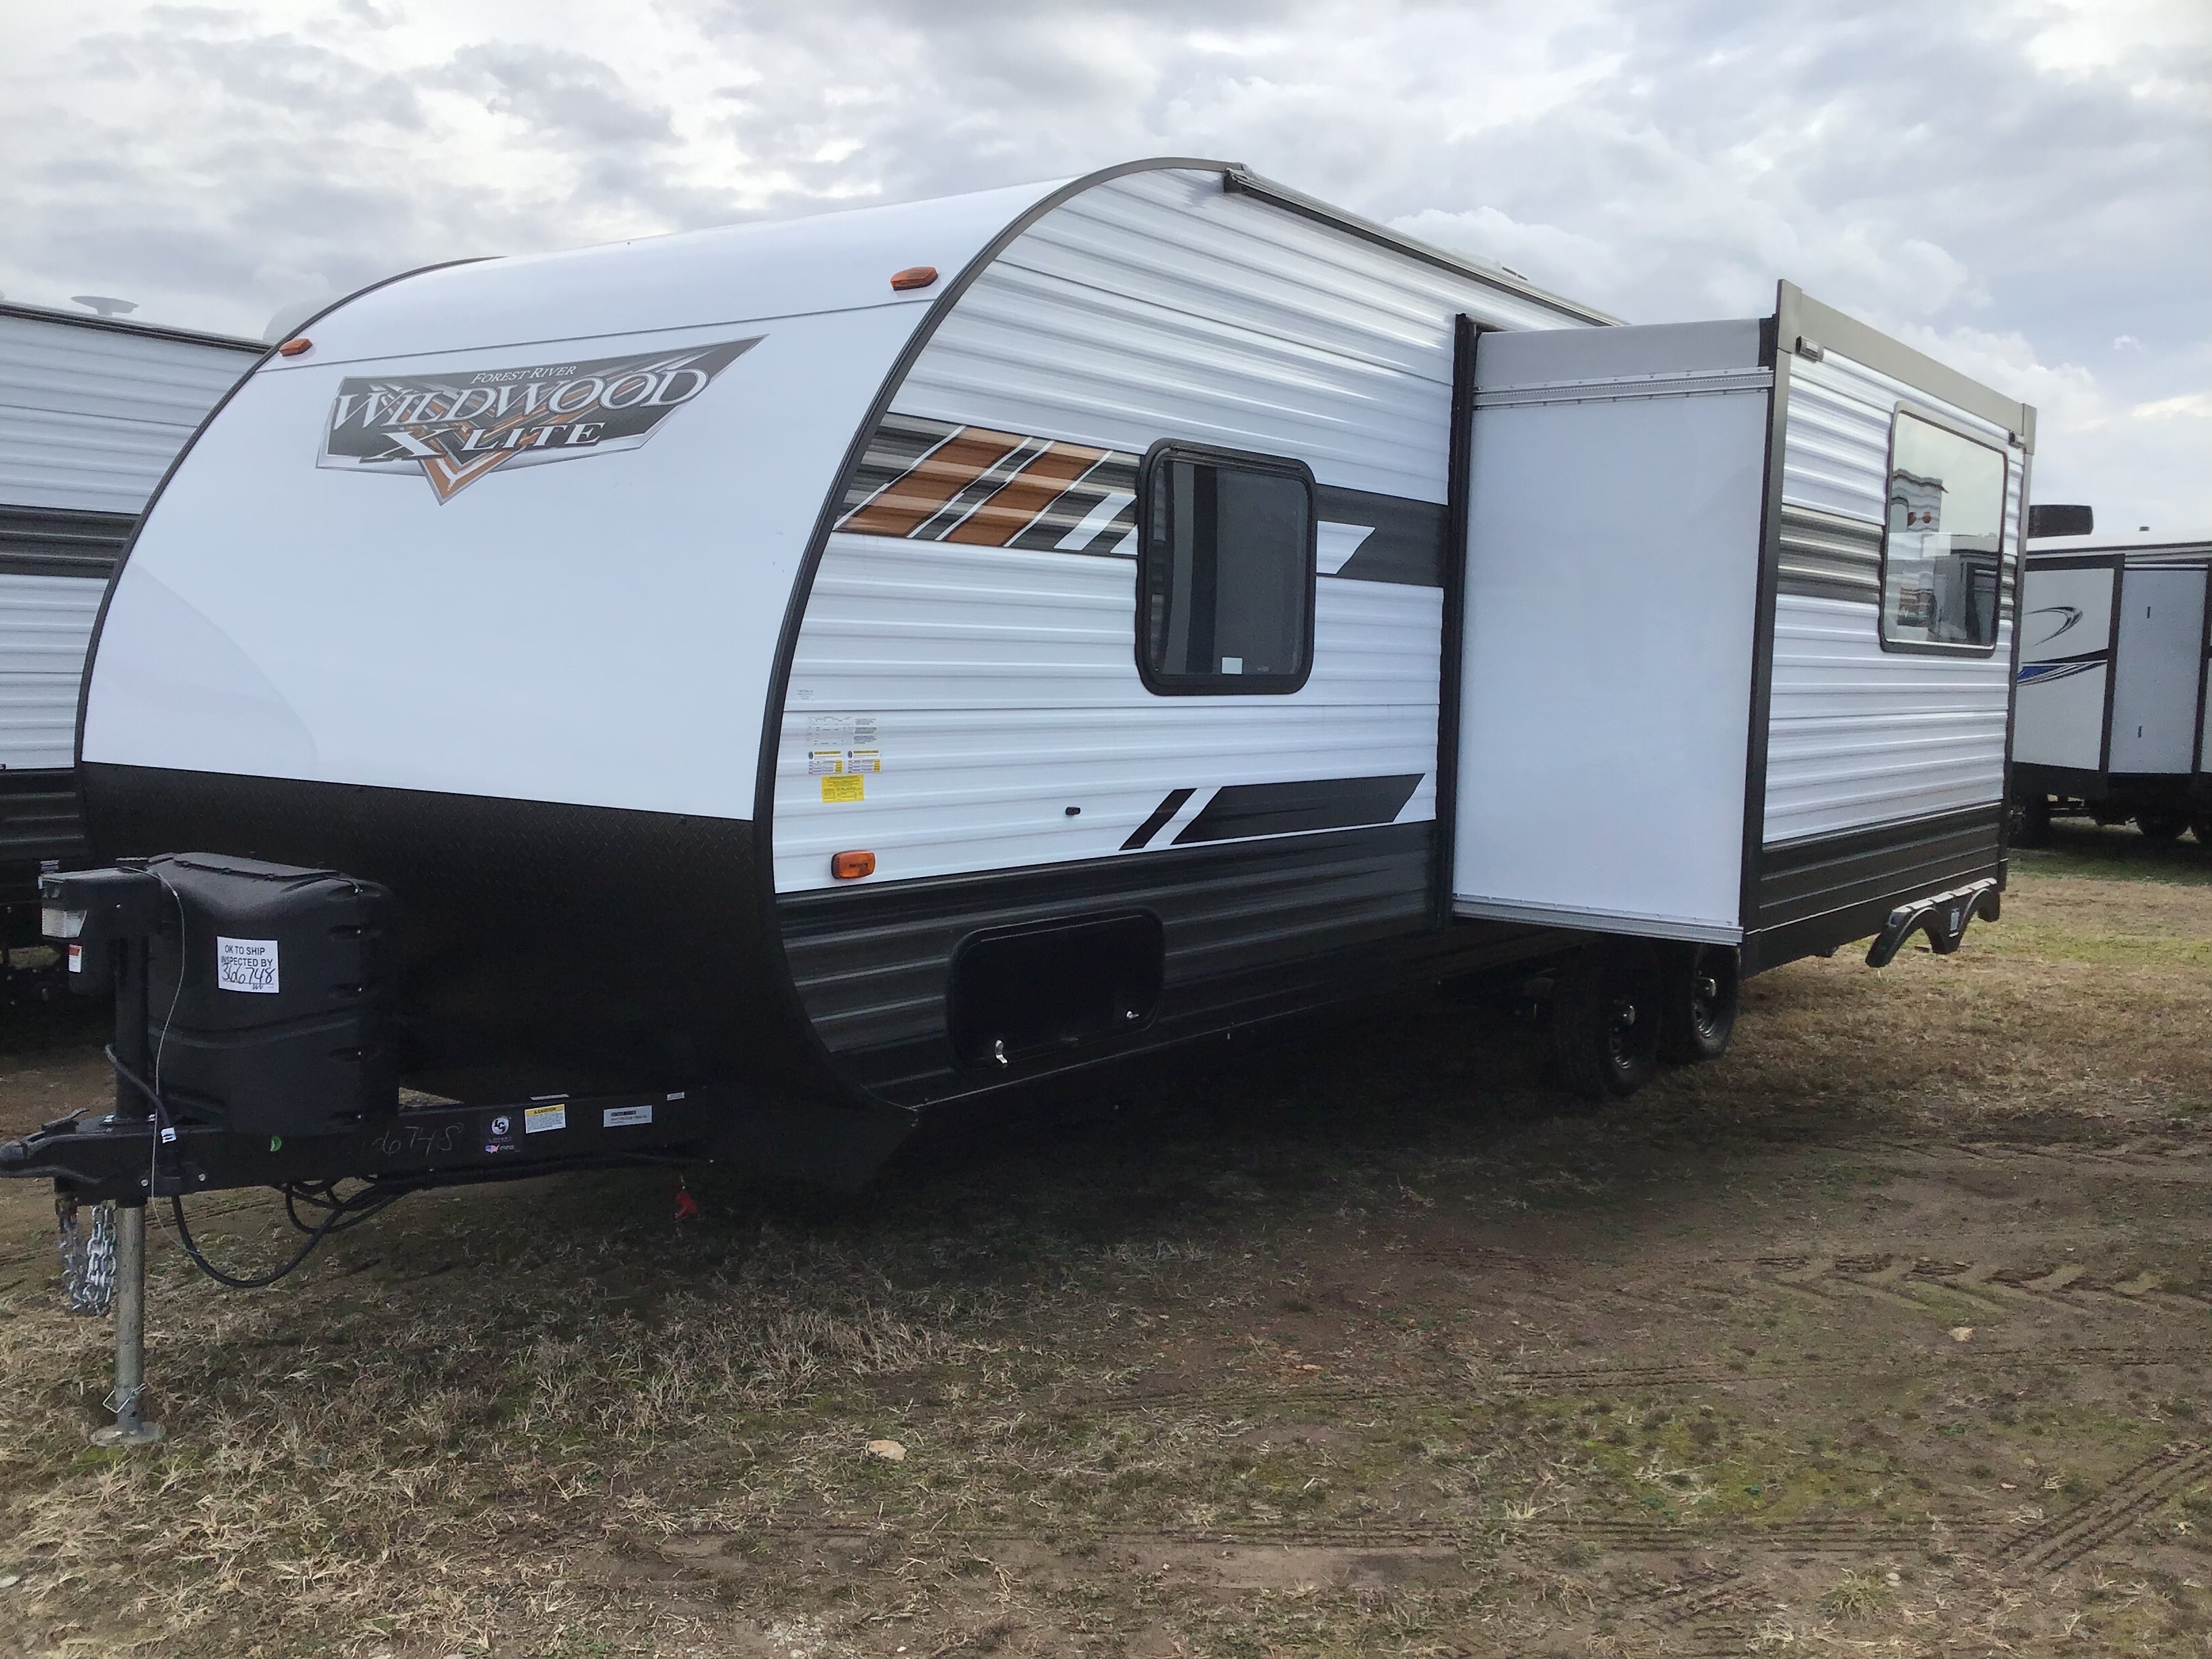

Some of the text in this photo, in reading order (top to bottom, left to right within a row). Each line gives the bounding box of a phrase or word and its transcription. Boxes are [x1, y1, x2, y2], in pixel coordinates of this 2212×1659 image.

[470, 365, 577, 384] FOREST RIVER
[333, 368, 710, 430] WILDWOOD
[459, 422, 606, 451] LITE
[224, 945, 266, 956] OK TO SHIP
[260, 958, 273, 967] BY
